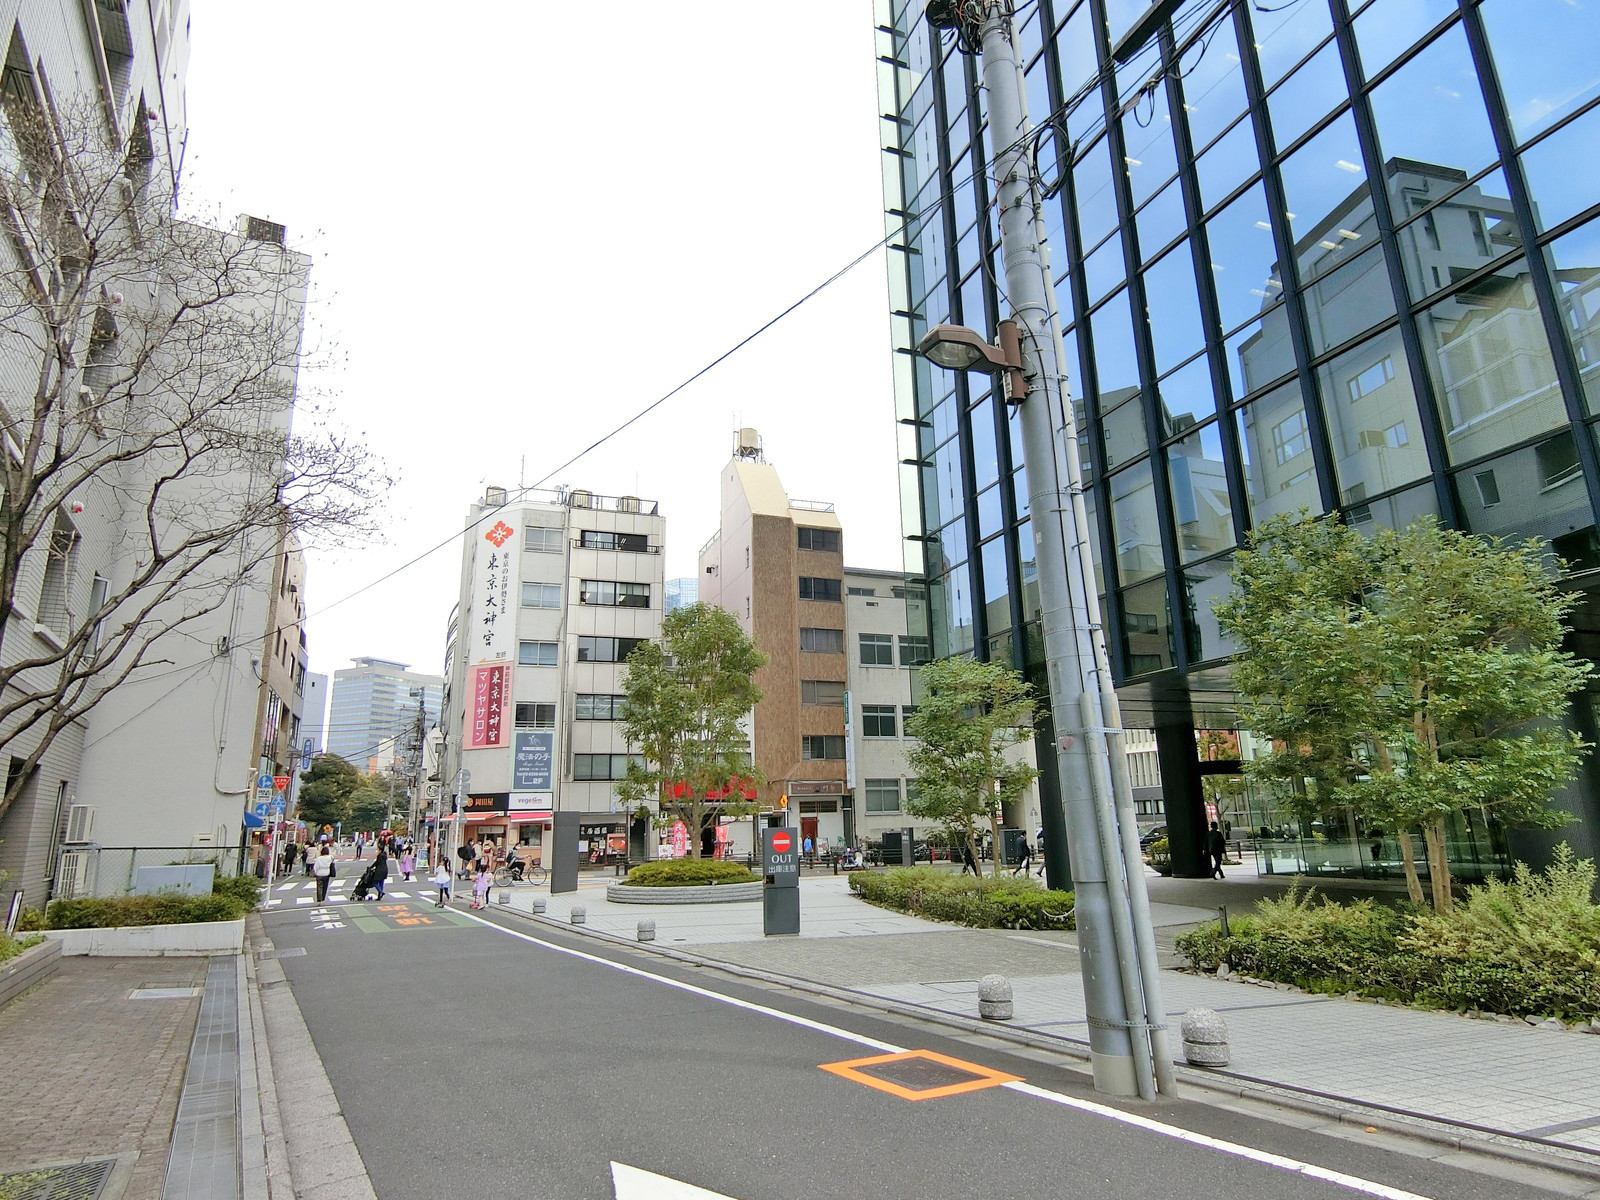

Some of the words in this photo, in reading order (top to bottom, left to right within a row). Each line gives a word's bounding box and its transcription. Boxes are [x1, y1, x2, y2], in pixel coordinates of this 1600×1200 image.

[482, 552, 499, 647] 東京大神宮
[500, 552, 510, 615] 東京のお伊勢さま
[475, 671, 488, 742] マツヤサロン
[488, 669, 501, 742] 東京大神宮
[516, 752, 551, 761] 魔法の手
[768, 864, 797, 874] 出庫注意
[771, 854, 793, 864] OUT
